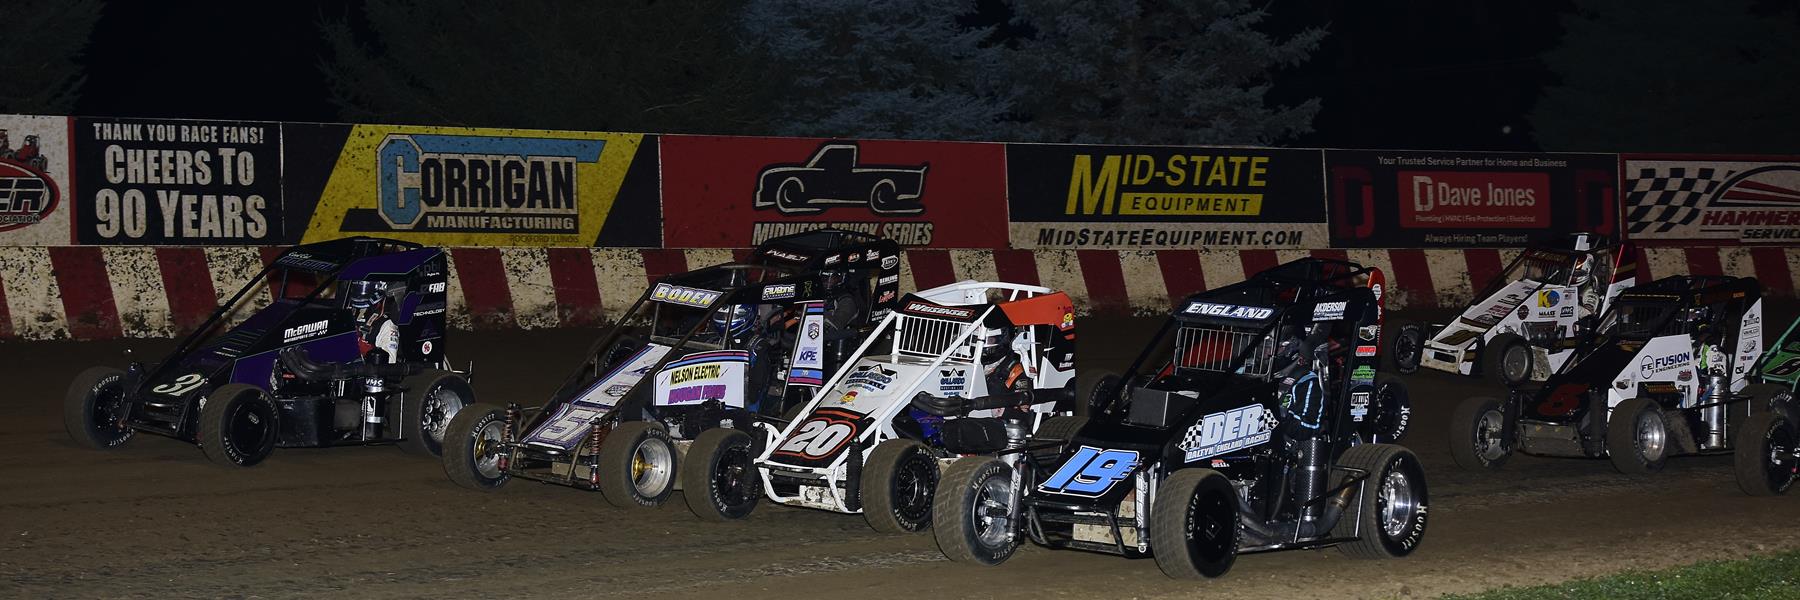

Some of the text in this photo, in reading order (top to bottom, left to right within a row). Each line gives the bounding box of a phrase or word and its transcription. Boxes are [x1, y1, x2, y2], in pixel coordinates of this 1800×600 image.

[93, 122, 264, 144] THANK YOU RACE FANS!
[1378, 156, 1567, 169] Your Trusted Service Partner for Home and Business
[379, 137, 575, 225] CORRIGAN
[1064, 154, 1270, 215] MID-STATE
[1438, 182, 1481, 207] Dave
[1486, 182, 1536, 207] Jones
[1131, 196, 1250, 212] EQUIPMENT
[95, 188, 268, 239] 90 YEARS
[427, 214, 575, 230] MANUFACTURING
[1415, 214, 1536, 223] Plumbing HVAC Fire Protection Electrical
[1701, 210, 1800, 226] HAMMER
[882, 222, 933, 246] SERIES
[1424, 234, 1528, 244] Always Hiring Team Players!
[1741, 228, 1800, 240] SERVIC
[428, 282, 445, 293] FAB
[655, 285, 717, 305] BODEN
[413, 308, 445, 317] TECHNOLOGY
[1185, 301, 1274, 320] ENGLAND
[799, 351, 818, 361] KPE
[1655, 351, 1690, 368] FUSION
[669, 364, 721, 385] NELSON ELECTRIC
[1641, 362, 1653, 372] FE
[1655, 361, 1690, 373] ENGINEERING
[1199, 403, 1264, 447] DER
[776, 419, 855, 458] 20
[1216, 441, 1244, 456] ENGLAND
[1245, 433, 1270, 447] RACING
[972, 466, 1001, 491] Hoosier
